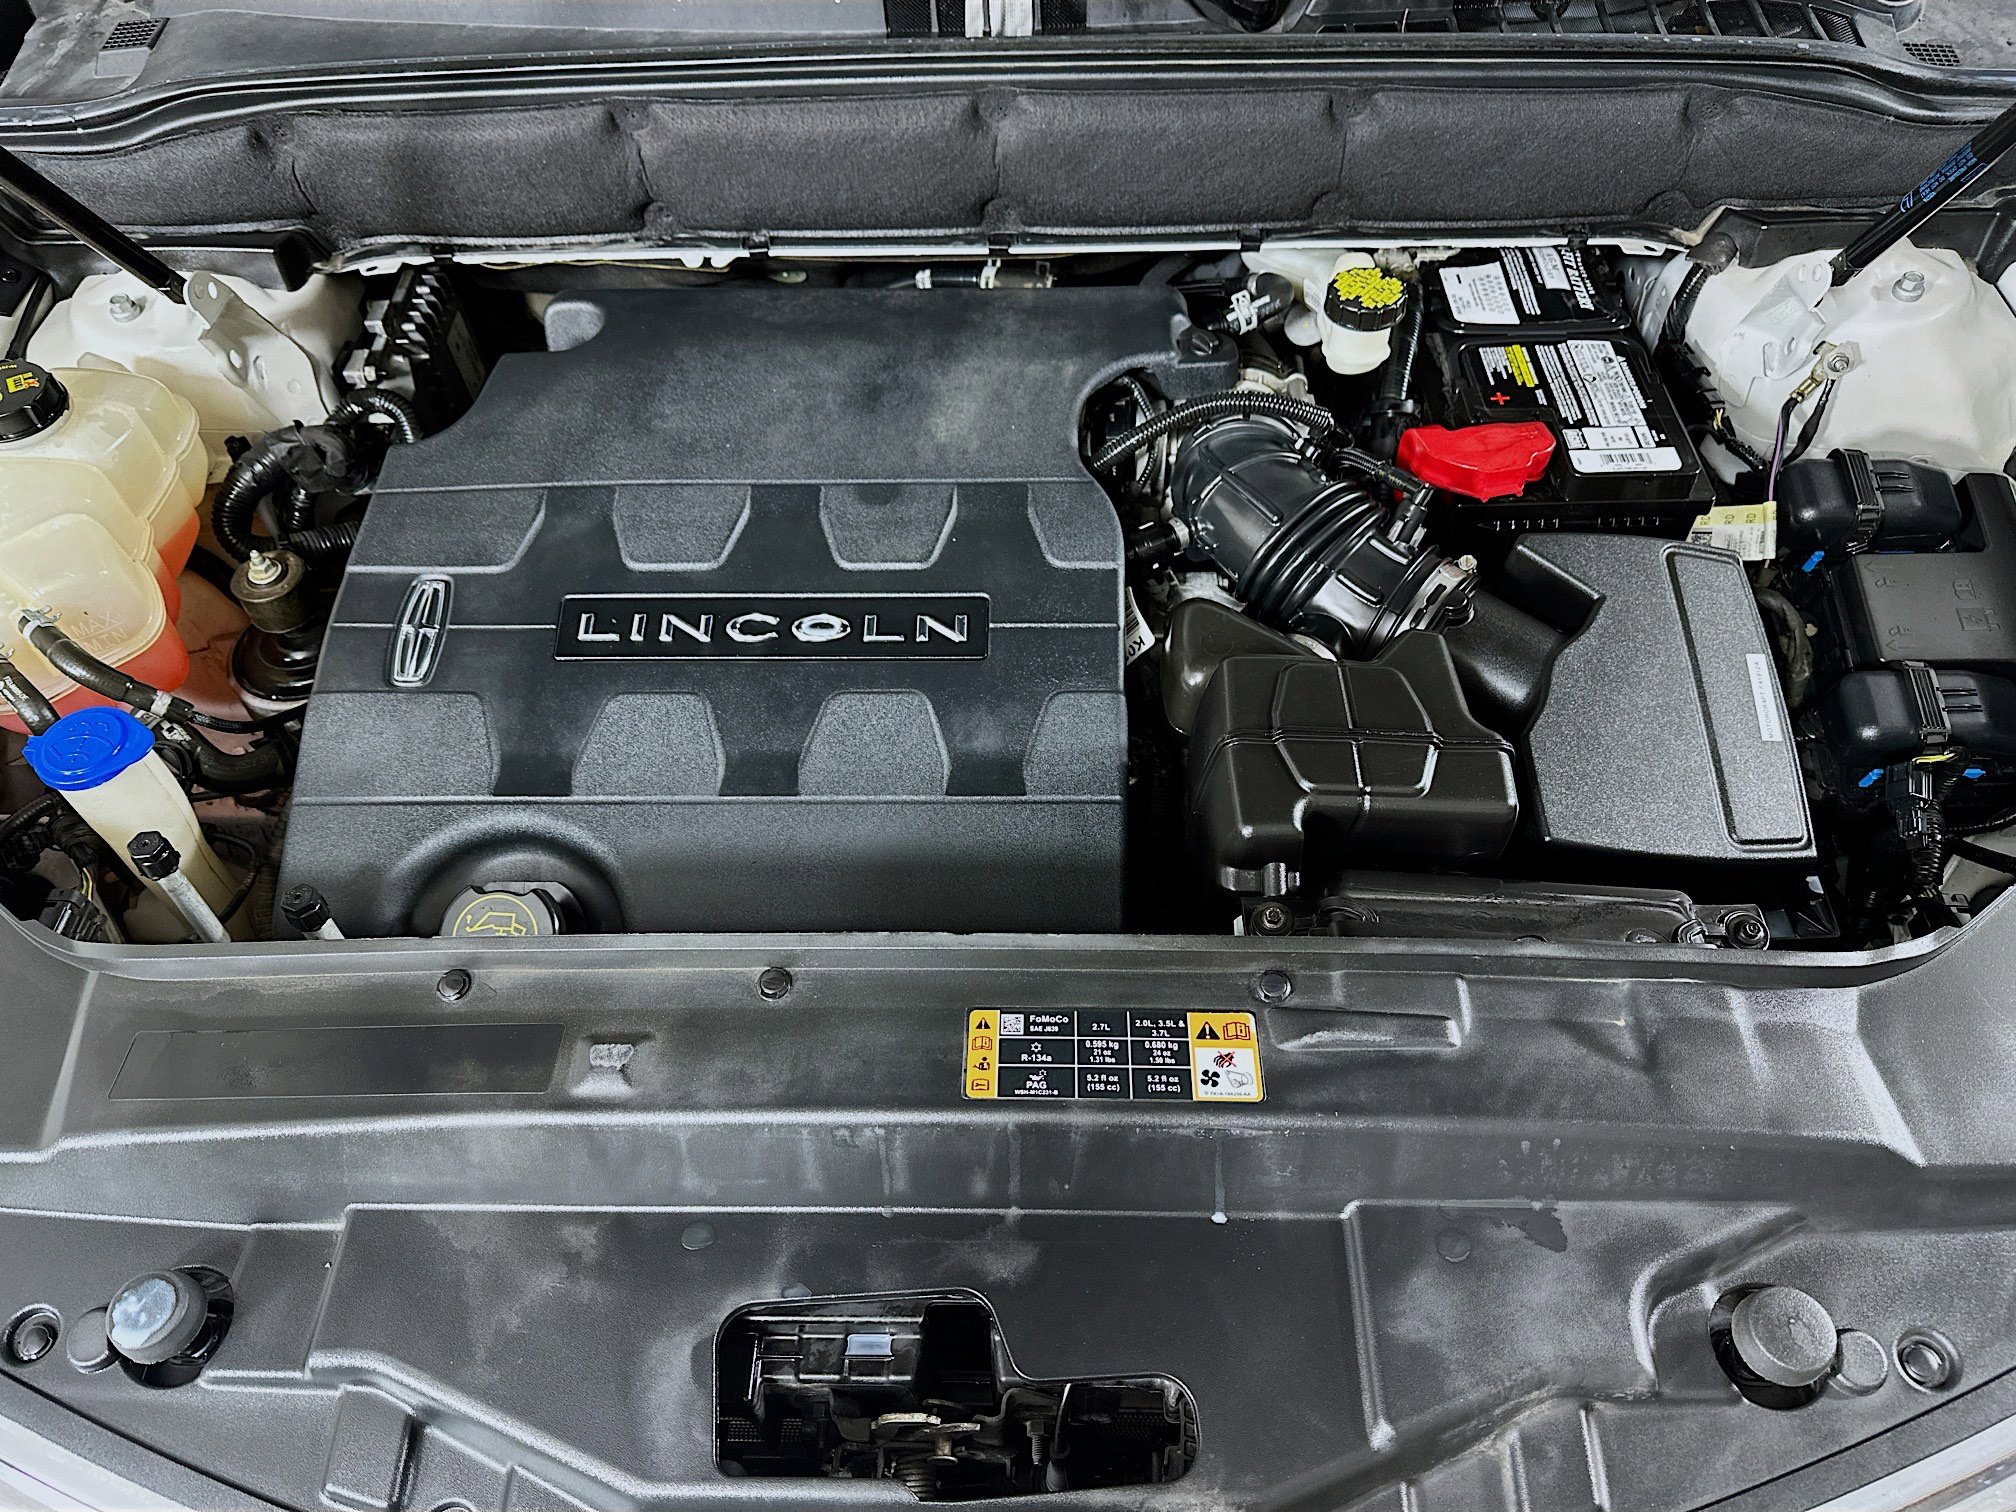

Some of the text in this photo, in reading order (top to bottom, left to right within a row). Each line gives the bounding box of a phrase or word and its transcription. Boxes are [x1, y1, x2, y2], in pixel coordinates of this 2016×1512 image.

[1724, 514, 1735, 525] RD
[1746, 513, 1756, 524] RD
[70, 611, 119, 638] MAX
[576, 612, 969, 643] LINCOLN
[82, 627, 130, 653] MIN
[1029, 1014, 1069, 1024] FoMoCo
[1134, 1019, 1186, 1028] 2.0L, 3.5L &
[1091, 1023, 1111, 1031] 2.7L
[1151, 1030, 1171, 1038] 3.7L
[1085, 1040, 1120, 1050] 0.595 kg
[1144, 1041, 1179, 1051] 0.680 kg
[1020, 1053, 1053, 1062] R-134a
[1086, 1074, 1099, 1082] 5.2
[1100, 1074, 1107, 1082] fl
[1147, 1074, 1160, 1083] 5.2
[1161, 1075, 1167, 1083] fl
[1026, 1081, 1047, 1090] PAG
[1087, 1083, 1120, 1092] (155 cc)
[1147, 1084, 1181, 1093] (155 cc)
